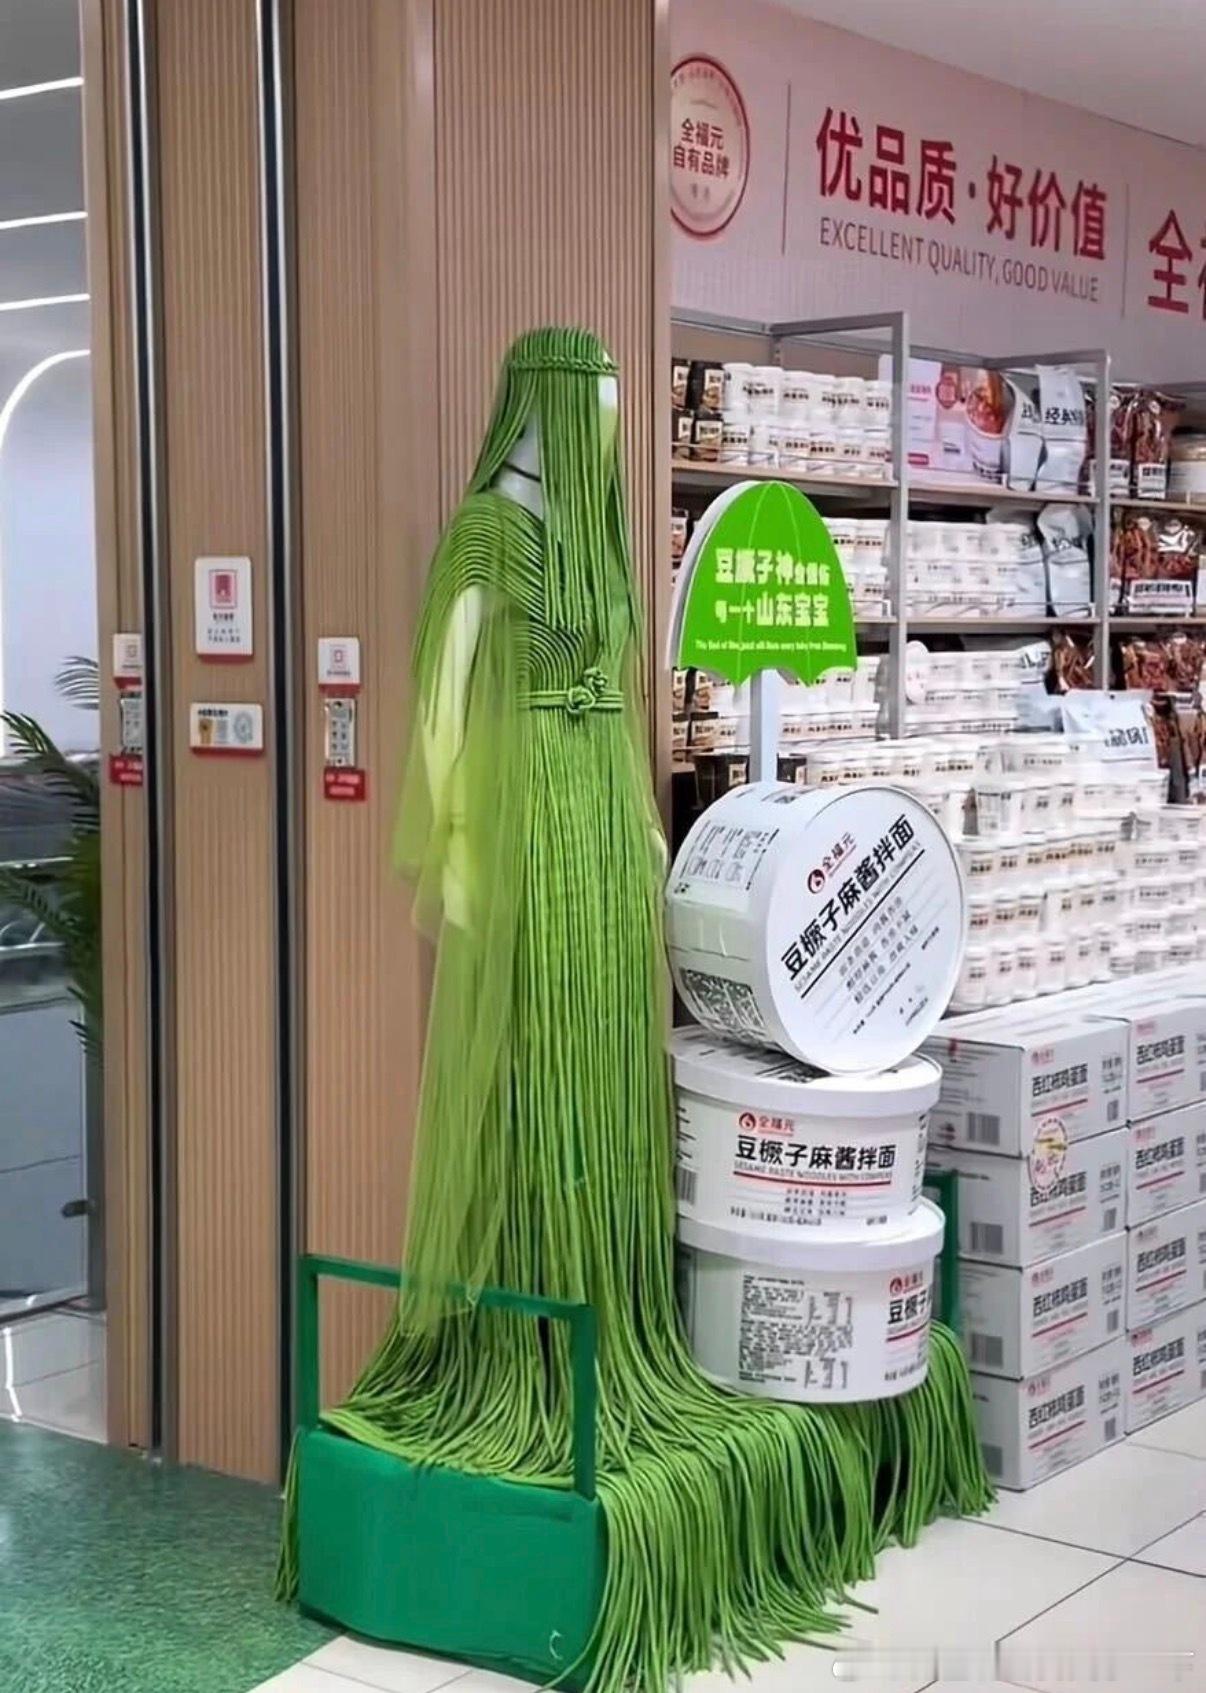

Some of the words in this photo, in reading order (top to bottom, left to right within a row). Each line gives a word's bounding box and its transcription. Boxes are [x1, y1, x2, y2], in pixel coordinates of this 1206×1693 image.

[673, 144, 729, 179] 自有品牌
[681, 118, 723, 150] 全福元
[816, 106, 1107, 260] 优品质·好价值
[819, 217, 925, 263] EXCELLENT
[928, 243, 1000, 286] QUALITY,
[1003, 258, 1048, 293] GOOD
[1052, 269, 1098, 303] VALUE
[780, 814, 915, 981] 豆橛子麻酱拌面
[735, 1134, 896, 1171] 豆橛子麻酱拌面
